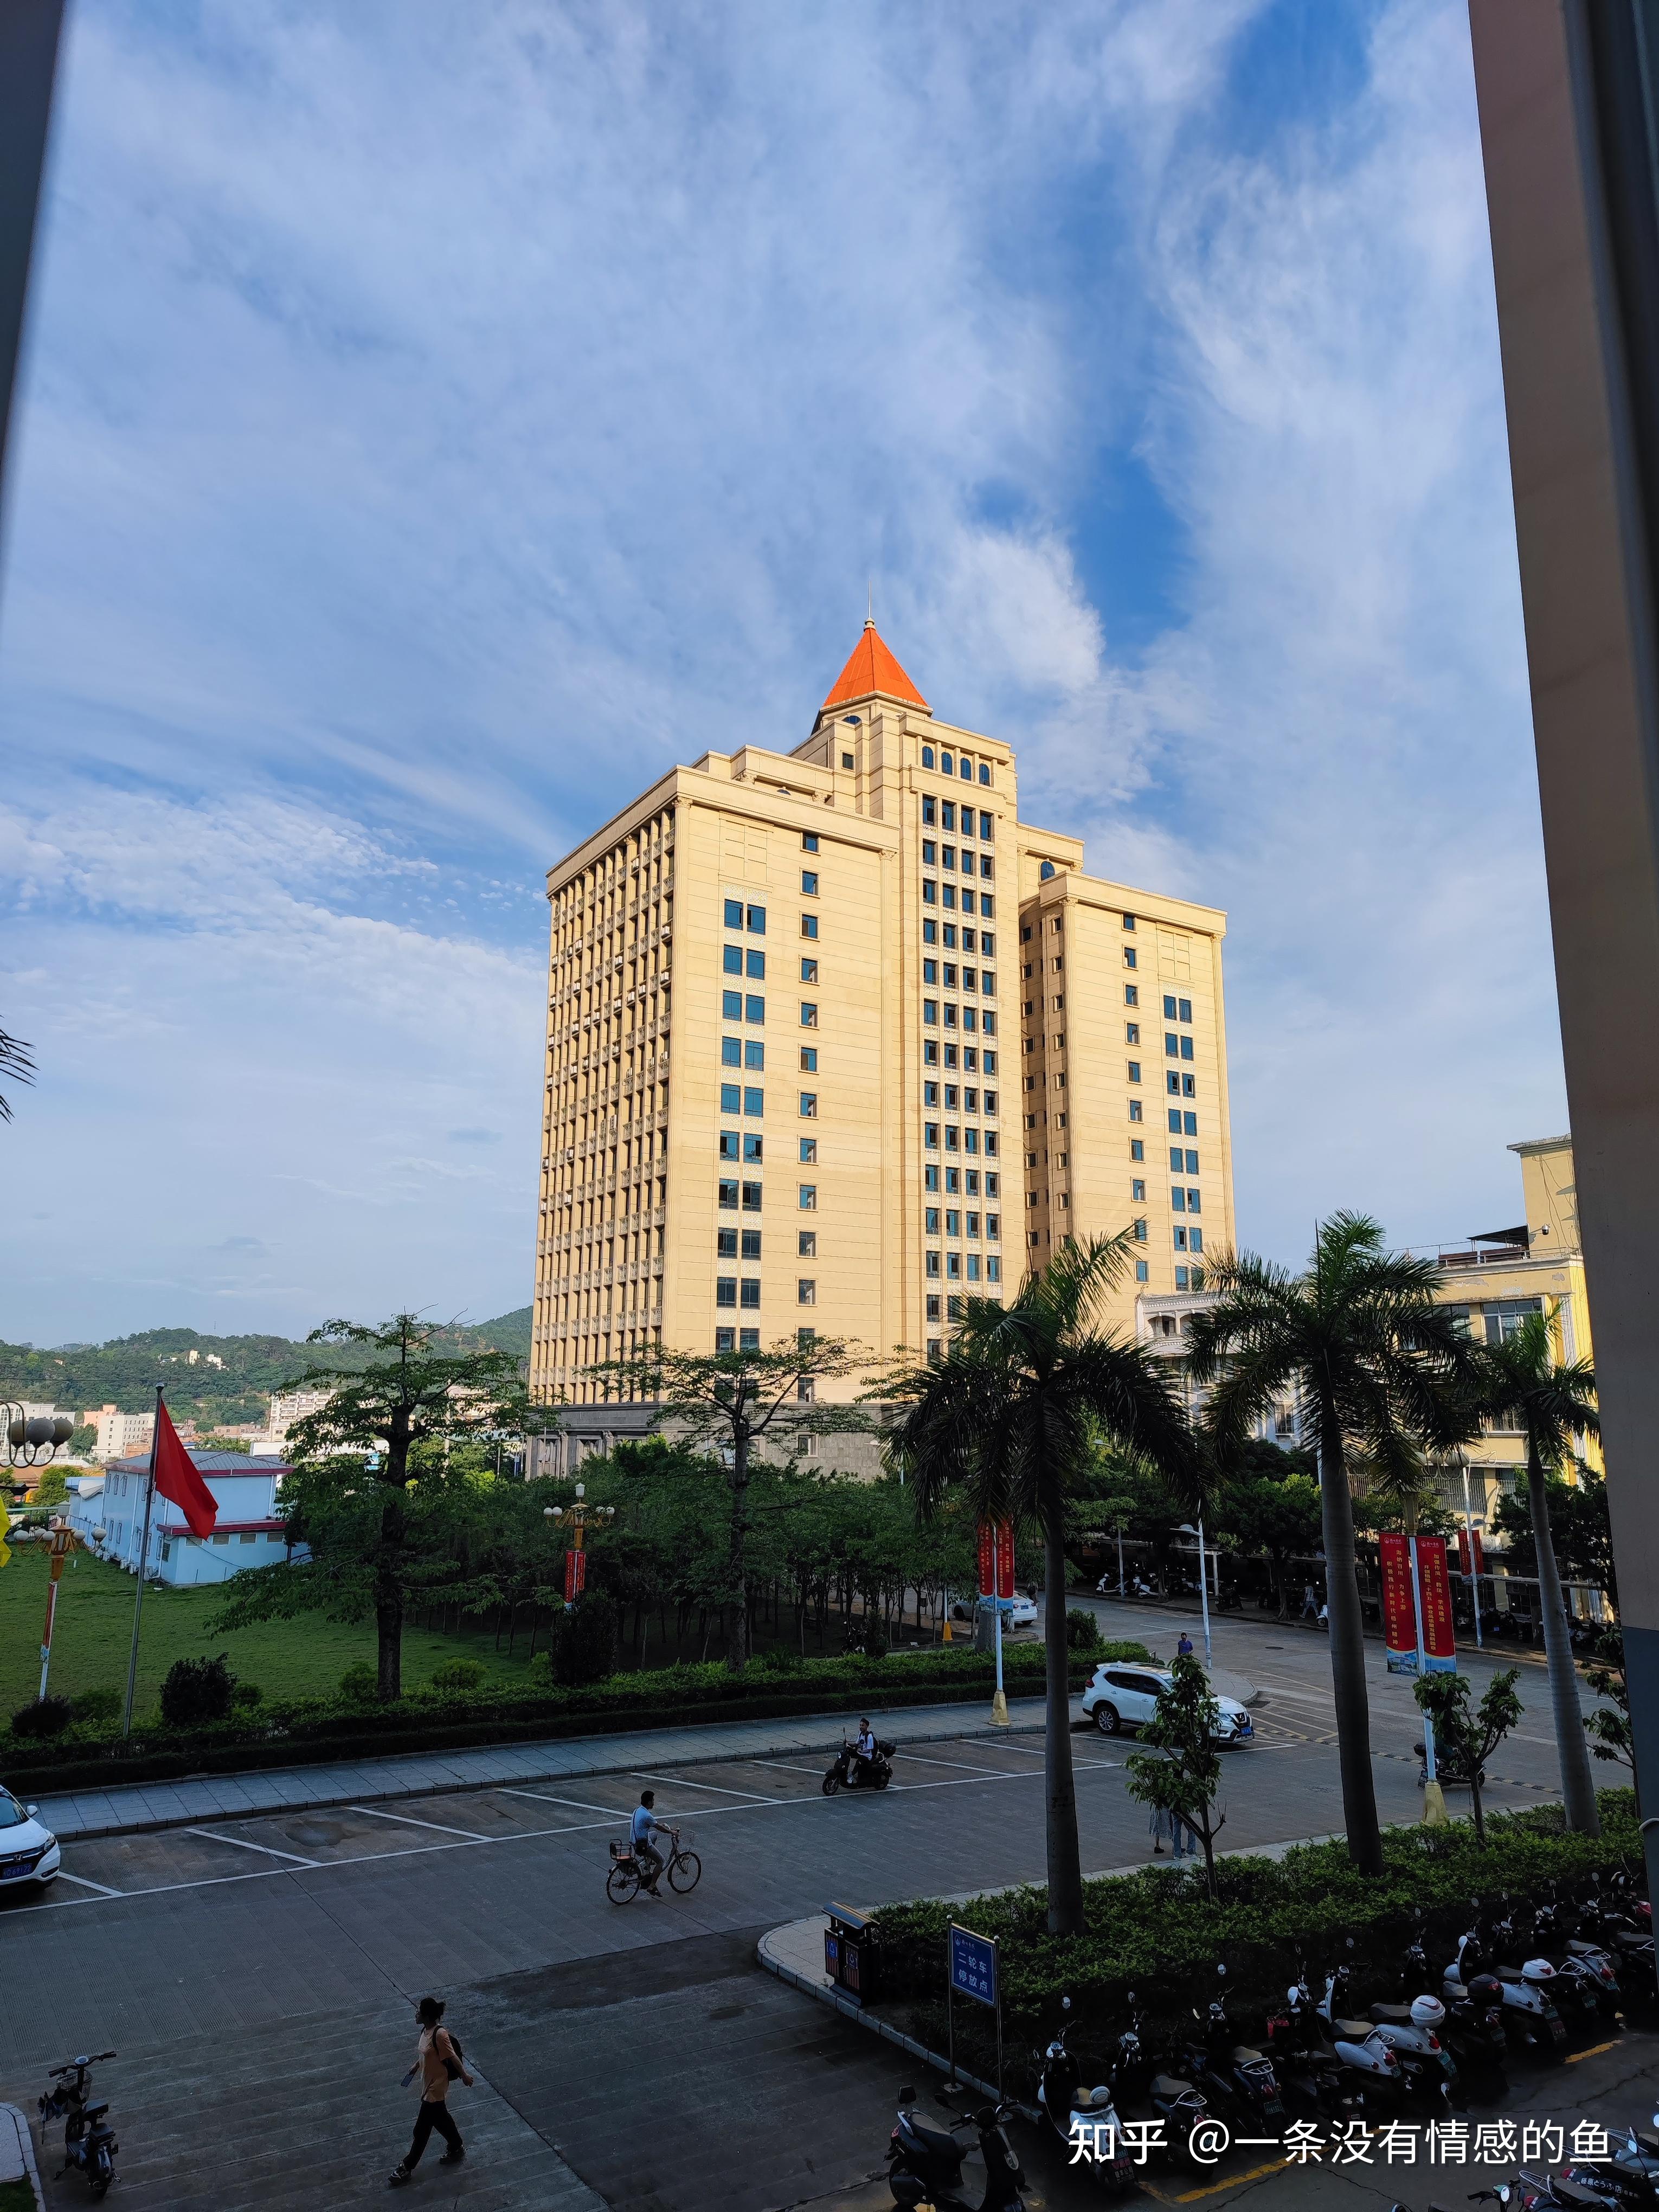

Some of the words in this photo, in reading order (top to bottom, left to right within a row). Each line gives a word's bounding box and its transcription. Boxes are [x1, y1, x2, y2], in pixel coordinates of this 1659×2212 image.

[958, 1951, 987, 1974] 二轮车
[958, 1969, 988, 1994] 停放点
